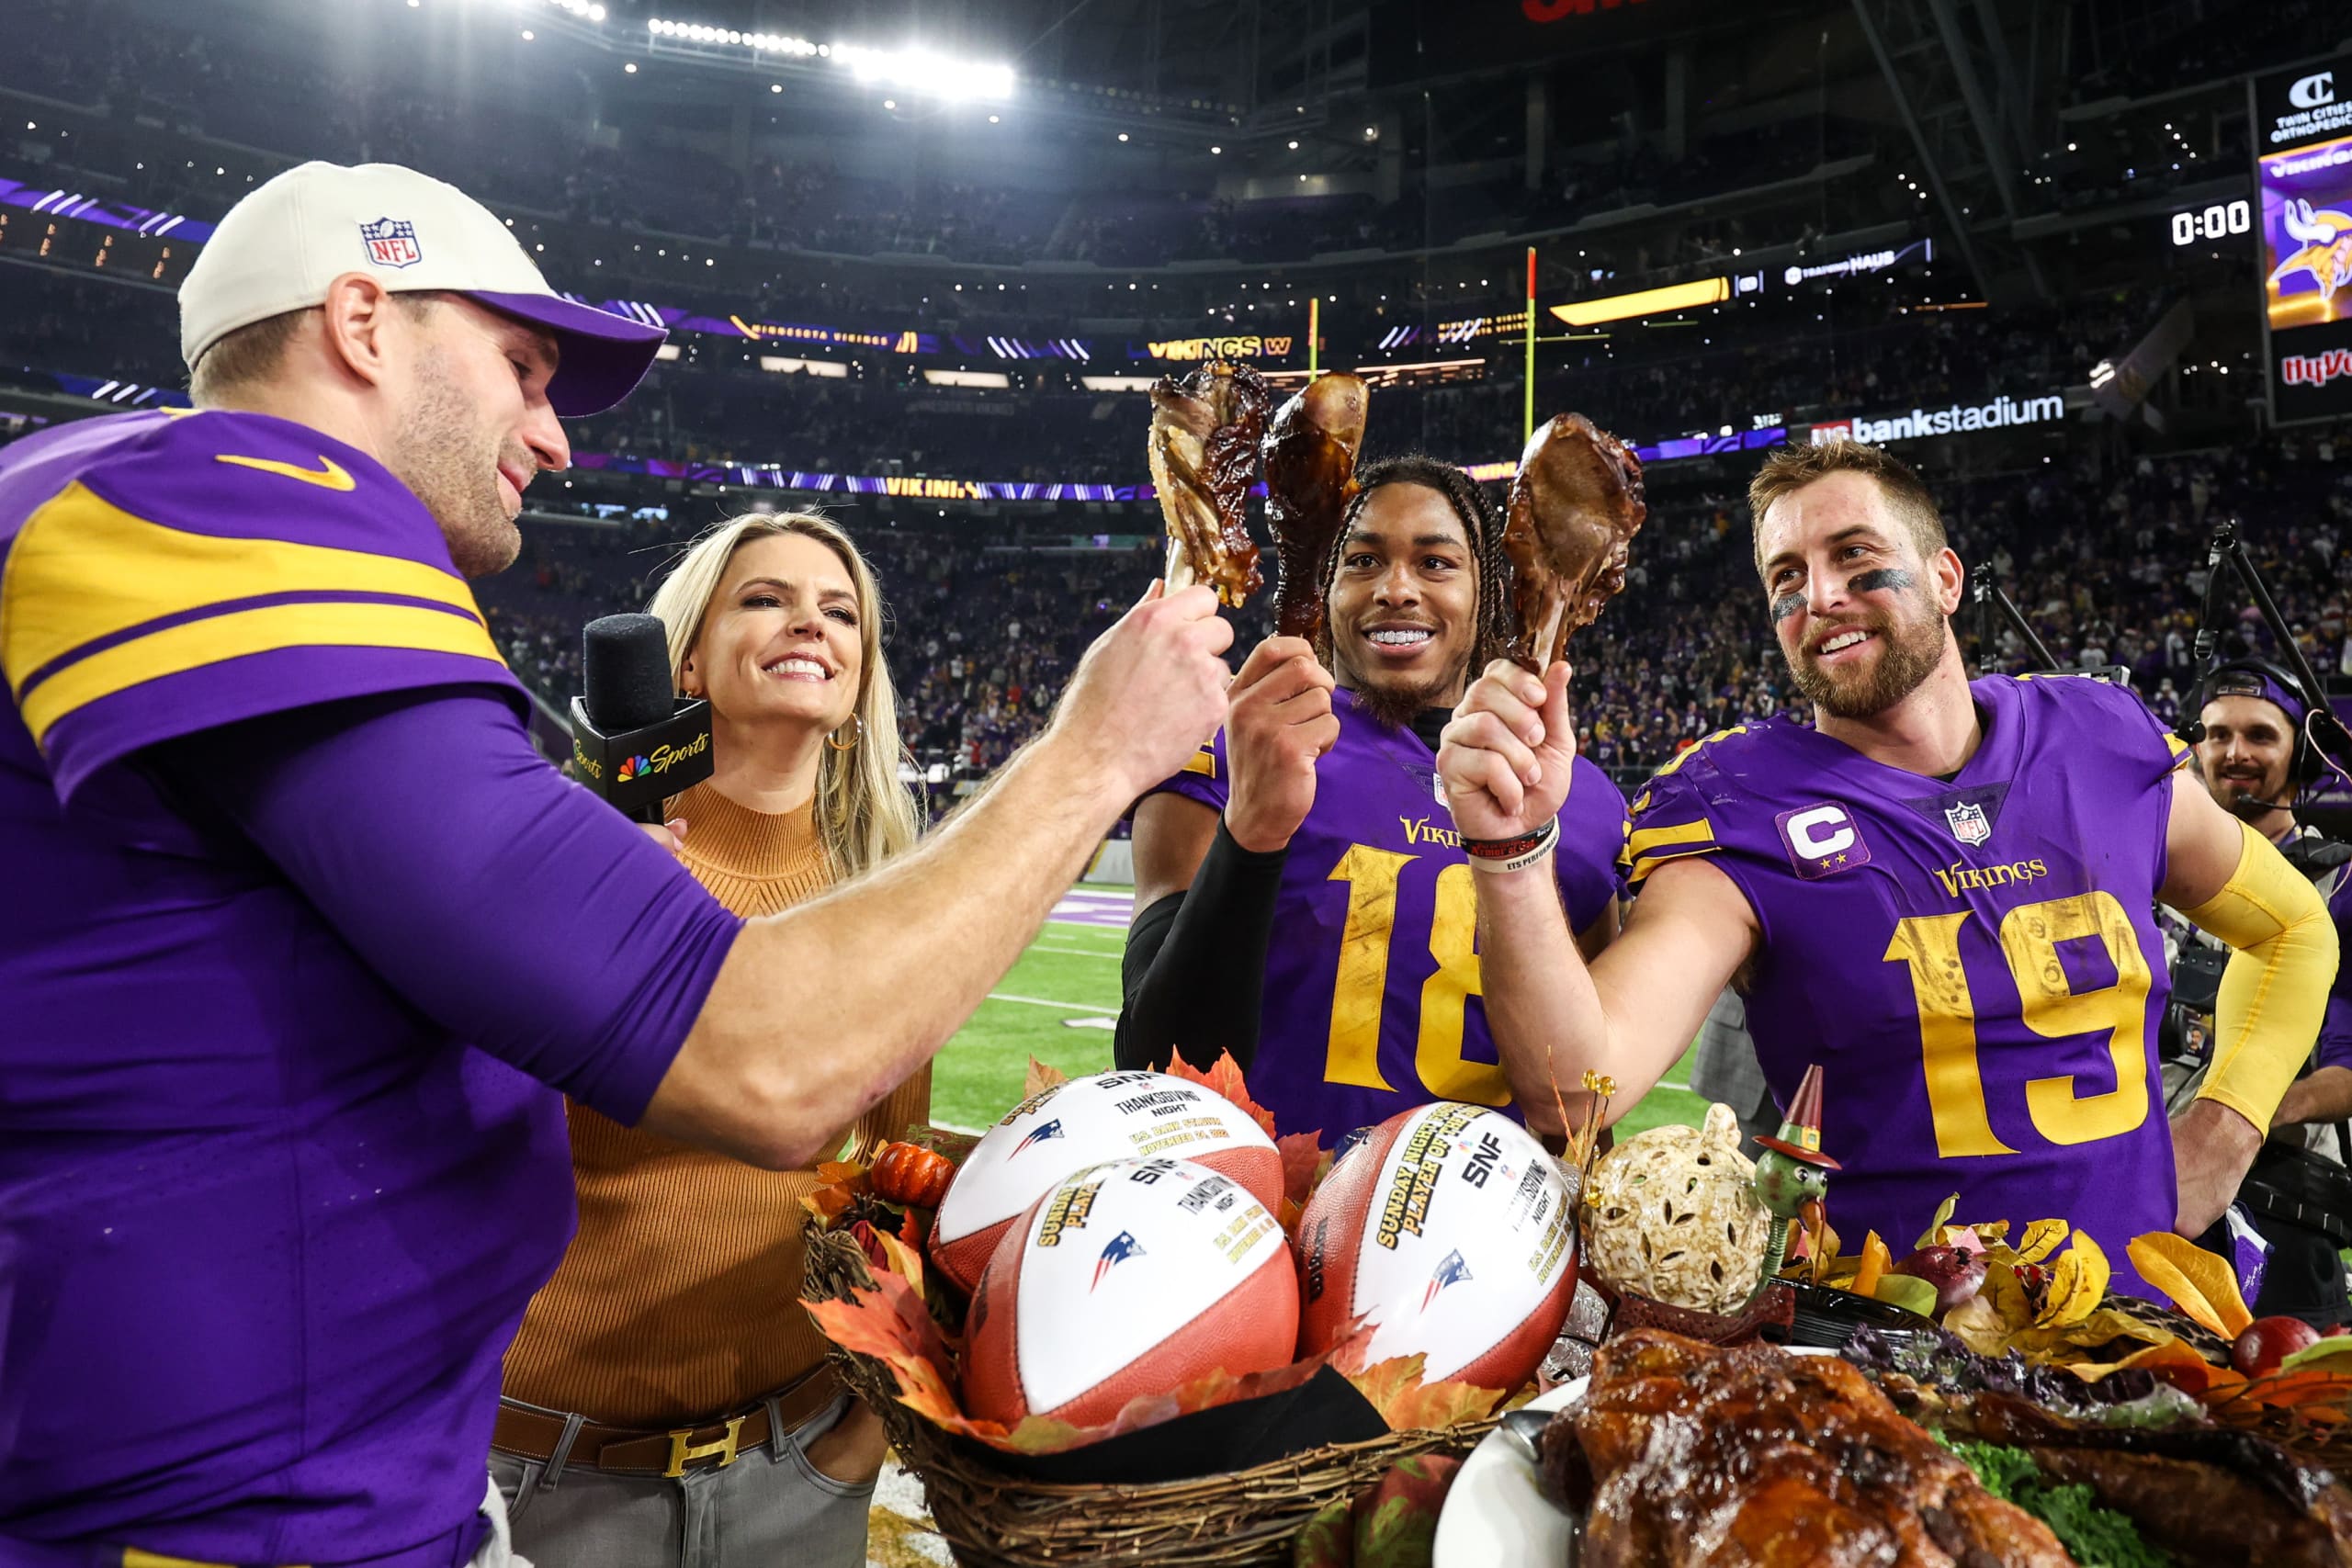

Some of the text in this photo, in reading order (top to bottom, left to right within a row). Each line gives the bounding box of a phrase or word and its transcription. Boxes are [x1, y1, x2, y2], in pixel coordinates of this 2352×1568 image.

[2276, 111, 2311, 129] TWIN
[2172, 200, 2250, 246] 0:00
[372, 239, 416, 263] NFL
[1850, 251, 1894, 271] HAUS
[650, 732, 709, 773] Sports
[1787, 805, 1855, 861] C
[1957, 819, 1984, 838] NFL
[1507, 860, 1521, 871] ETS
[1323, 842, 1512, 1107] 18
[1882, 890, 2153, 1159] 19
[1095, 1073, 1161, 1089] SNF
[1114, 1089, 1202, 1115] THANKSGIVING
[1150, 1103, 1188, 1118] NIGHT
[1439, 1117, 1472, 1137] THE
[1138, 1133, 1194, 1156] NOVEMBER
[1427, 1137, 1452, 1158] OF
[1129, 1158, 1178, 1185] SNF
[1462, 1132, 1502, 1190] SNF
[1376, 1166, 1417, 1250] SUNDAY
[1402, 1122, 1436, 1165] NIGHT
[1402, 1159, 1443, 1238] PLAYER
[1037, 1186, 1080, 1247] SUNDAY
[1532, 1190, 1553, 1226] NIGHT
[662, 1416, 746, 1478] H
